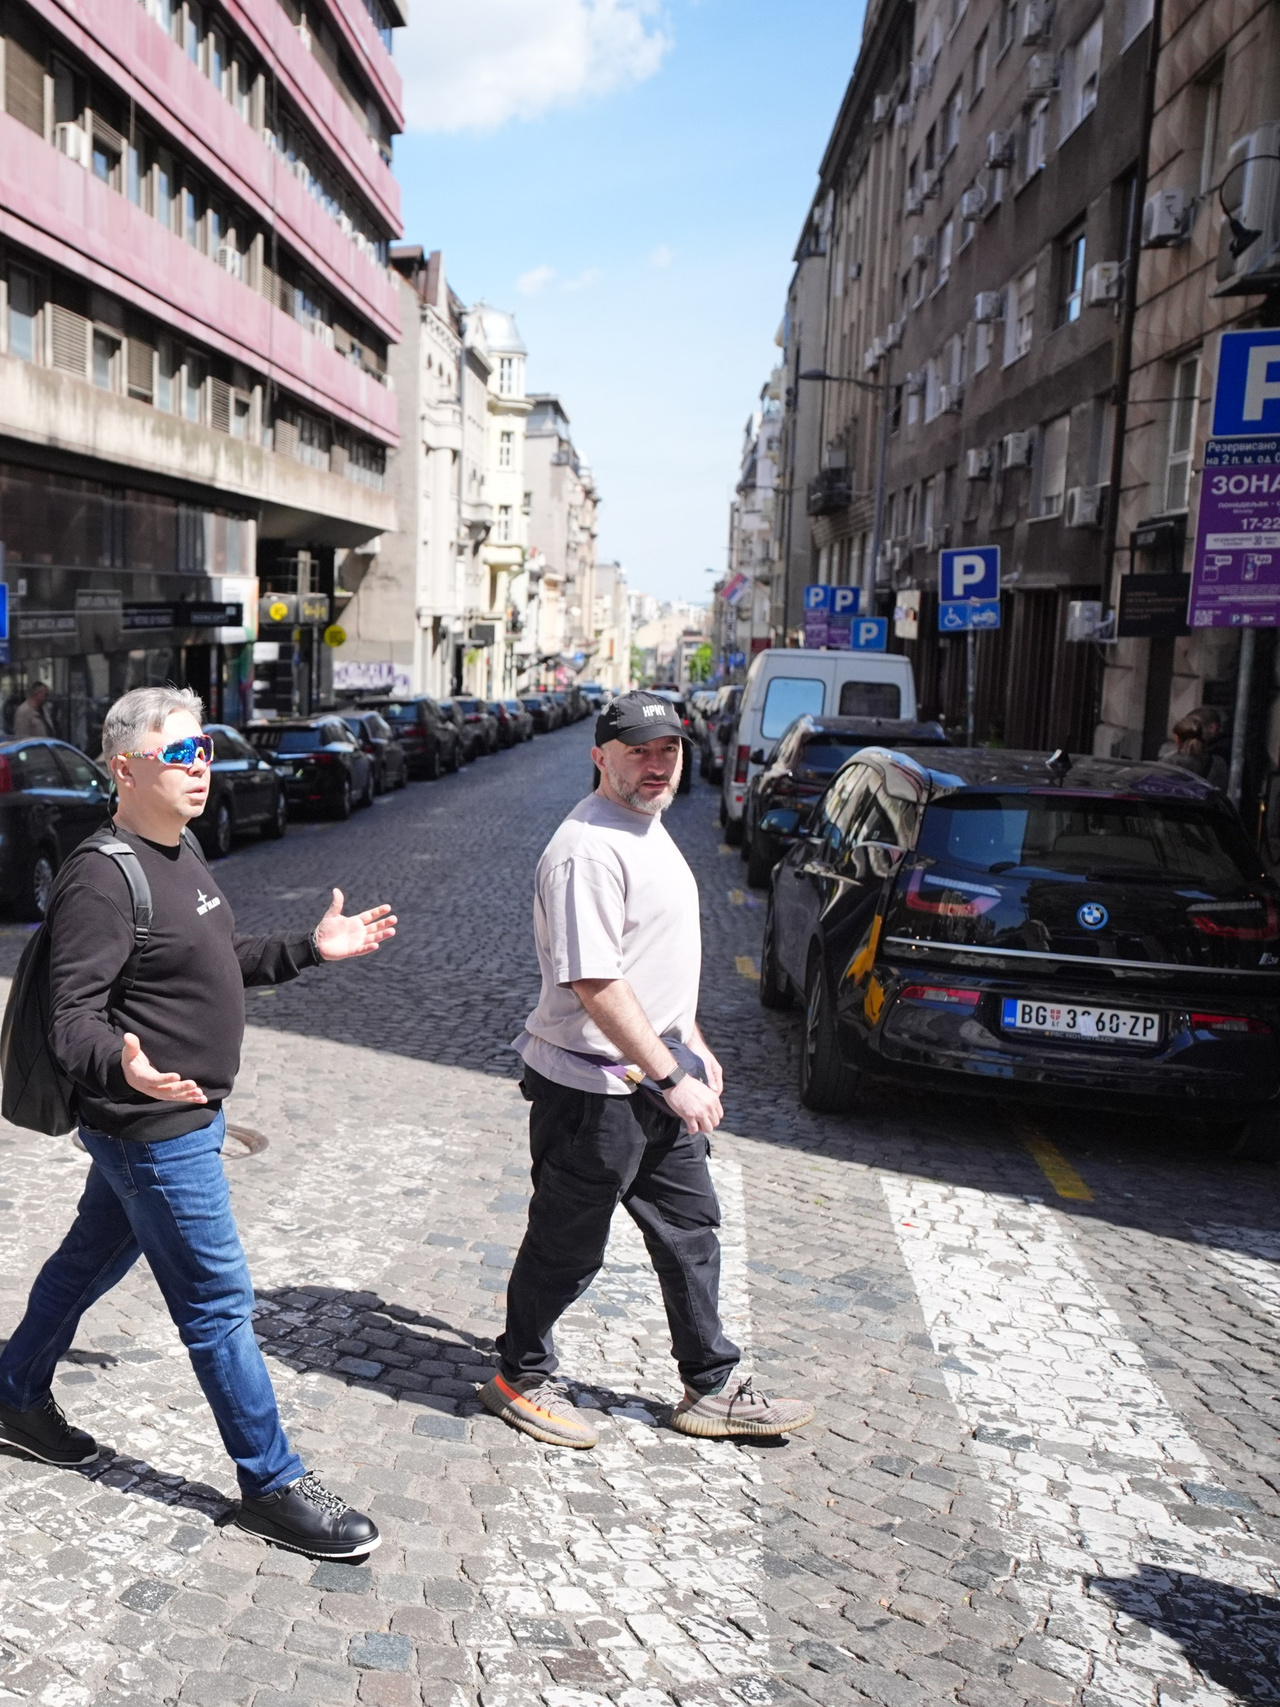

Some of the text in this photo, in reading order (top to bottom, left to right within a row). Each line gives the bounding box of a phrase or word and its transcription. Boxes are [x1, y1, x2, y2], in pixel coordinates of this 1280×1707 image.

[1242, 345, 1280, 421] P
[1207, 441, 1277, 453] Резервисано
[1206, 457, 1219, 465] на
[1222, 454, 1230, 465] 2
[952, 554, 986, 597] P
[809, 587, 825, 608] P
[834, 589, 854, 612] P
[859, 621, 879, 646] P
[1021, 1003, 1047, 1026] BG
